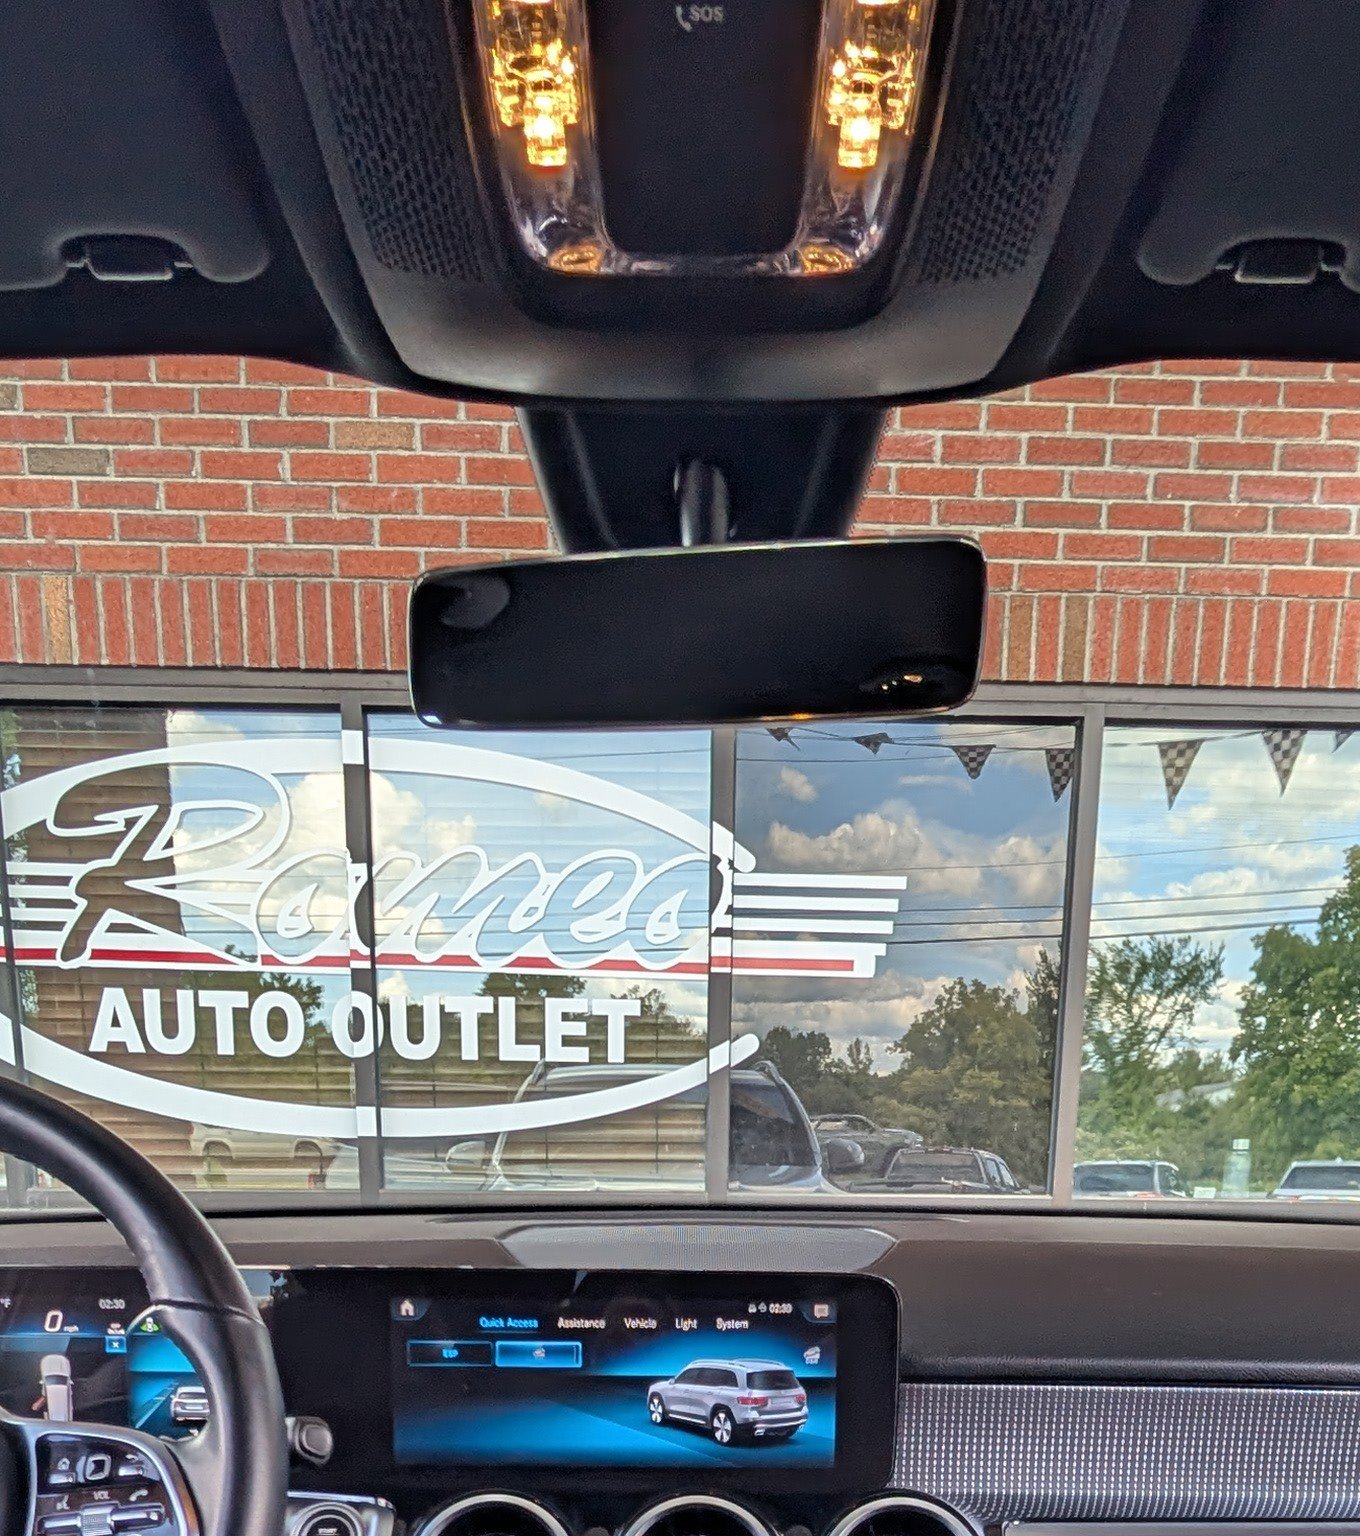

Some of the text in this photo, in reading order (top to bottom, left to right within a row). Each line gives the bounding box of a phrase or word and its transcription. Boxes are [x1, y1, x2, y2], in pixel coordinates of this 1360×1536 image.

[690, 5, 723, 21] SOS
[46, 760, 732, 971] Romeo
[88, 986, 642, 1064] AUTO OUTLET
[44, 1310, 63, 1332] 0
[479, 1316, 749, 1331] Quick Access Assistance Vehicle Light System
